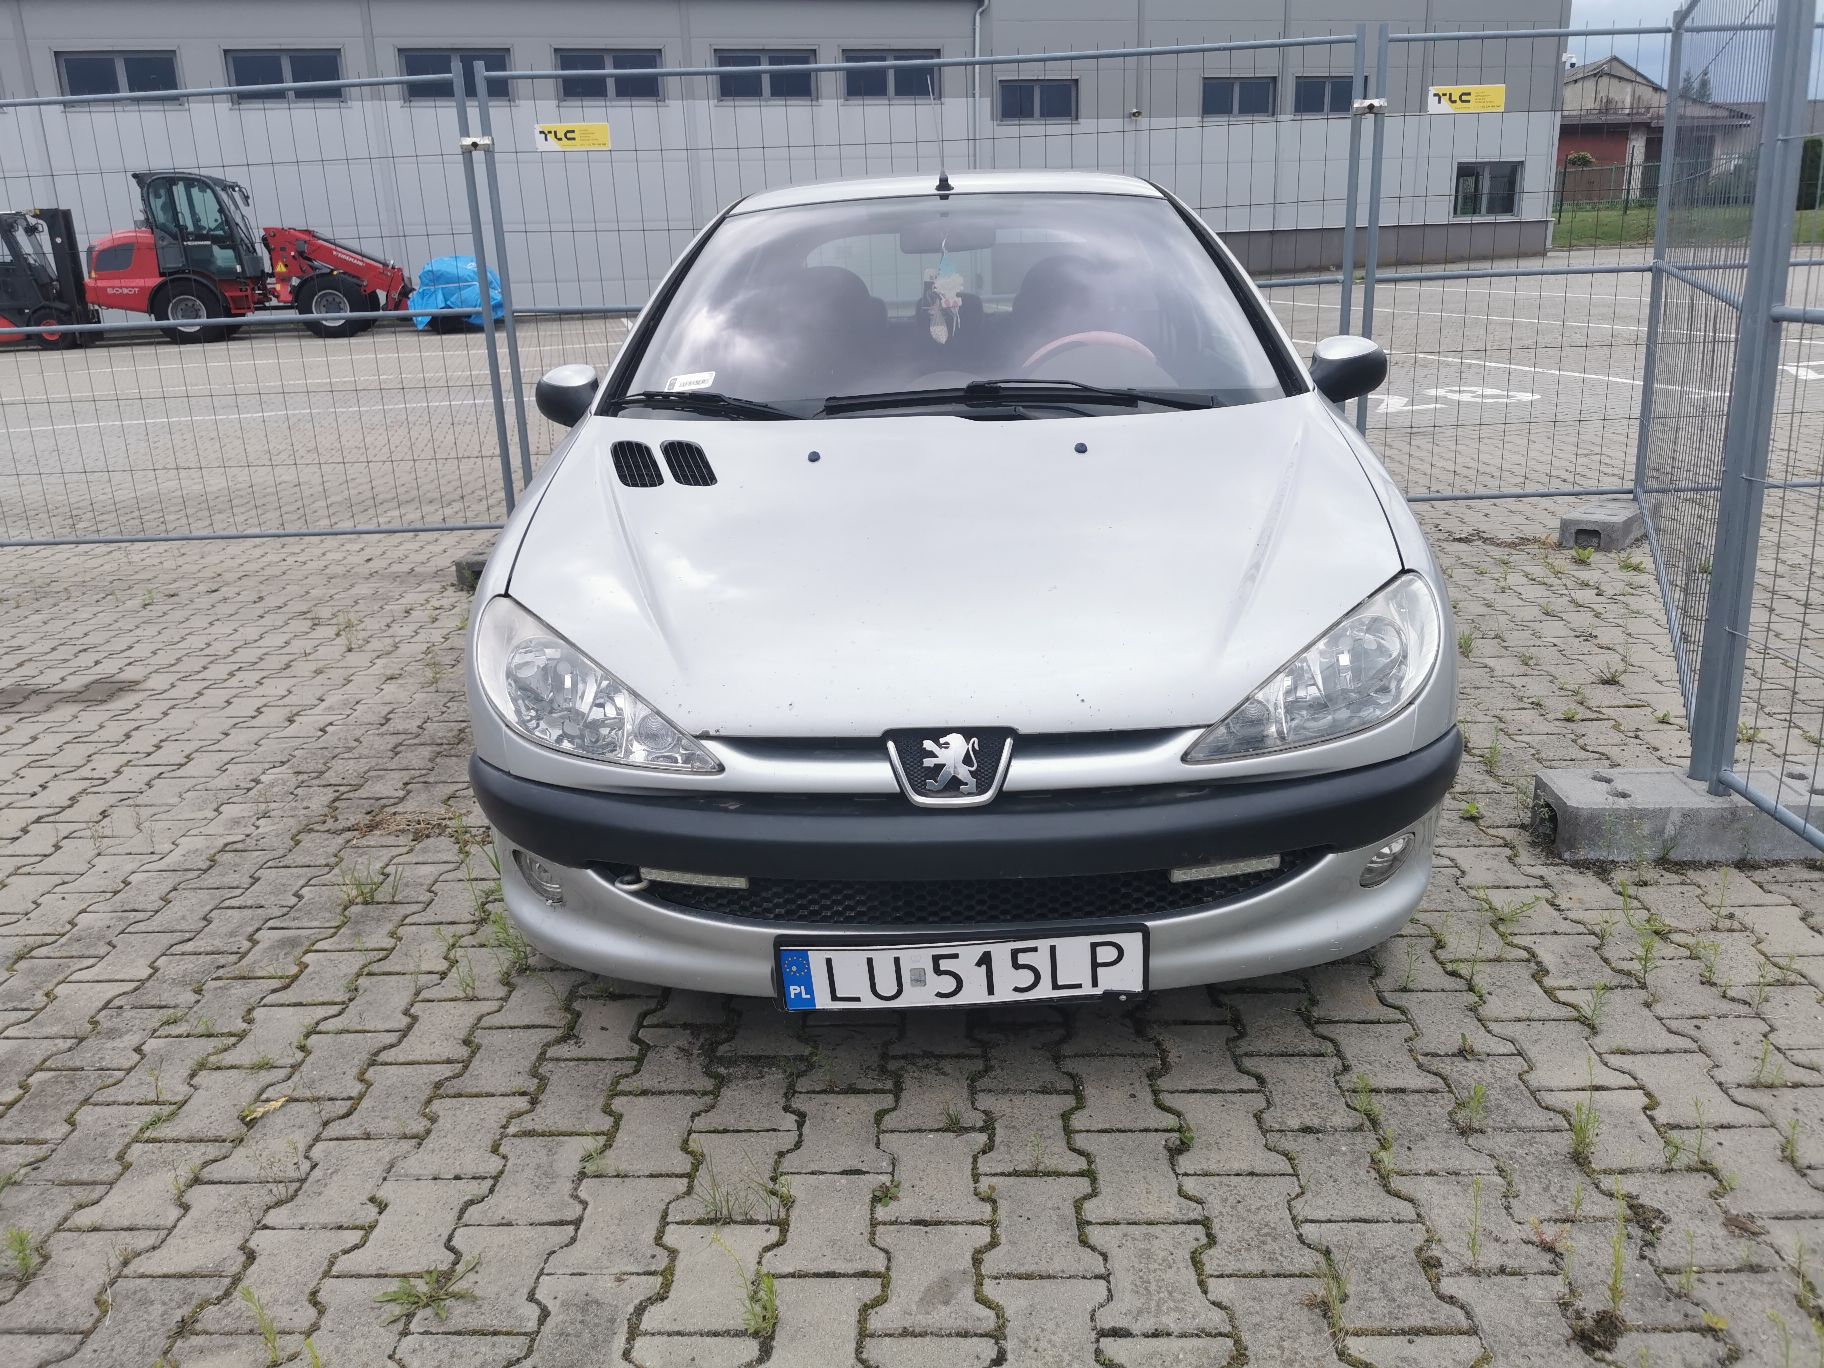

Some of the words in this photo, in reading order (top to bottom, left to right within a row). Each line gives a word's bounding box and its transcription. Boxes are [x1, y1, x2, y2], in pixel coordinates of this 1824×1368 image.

[1433, 92, 1471, 104] TLC
[539, 130, 576, 142] TLC
[825, 956, 904, 1003] LU
[931, 941, 1126, 1000] 515LP
[789, 985, 811, 999] PL
